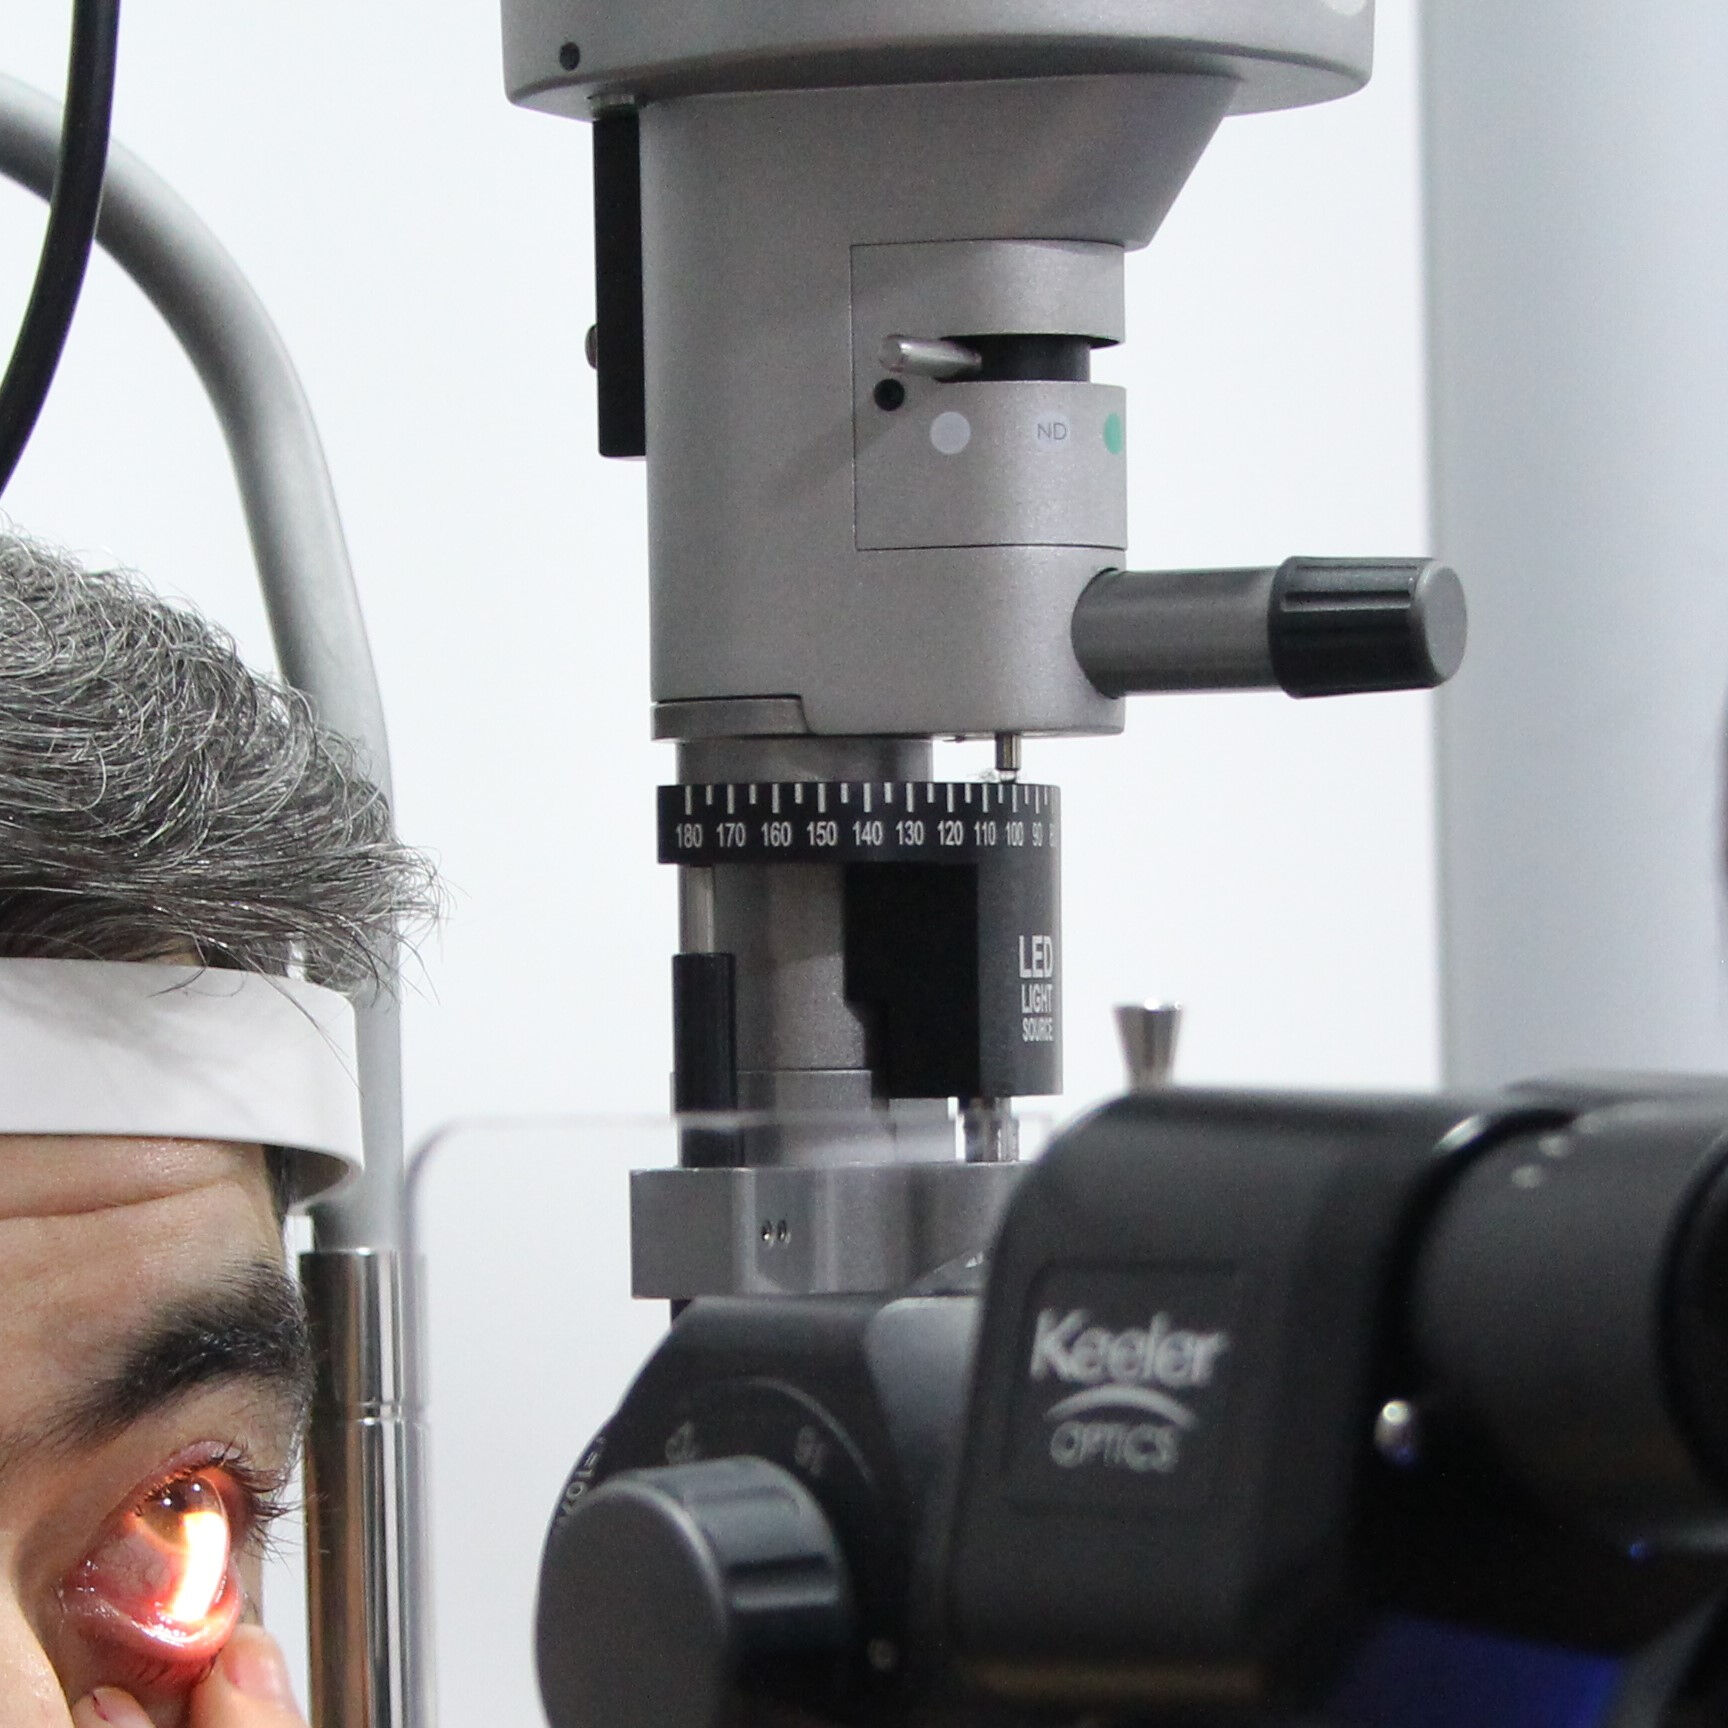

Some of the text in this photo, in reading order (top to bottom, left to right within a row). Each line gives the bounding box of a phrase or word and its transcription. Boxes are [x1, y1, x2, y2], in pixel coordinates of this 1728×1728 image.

[1036, 422, 1067, 440] ND
[676, 822, 703, 848] 180
[716, 822, 747, 847] 170
[761, 821, 793, 847] 160
[806, 821, 838, 846] 150
[852, 820, 884, 846] 140
[895, 820, 924, 846] 130
[937, 820, 964, 846] 120
[974, 821, 996, 846] 110
[1005, 821, 1024, 847] 100
[1018, 934, 1054, 978] LED
[1021, 983, 1053, 1014] LIGHT
[1030, 1307, 1230, 1388] Keeler
[1049, 1418, 1180, 1474] OPTICS
